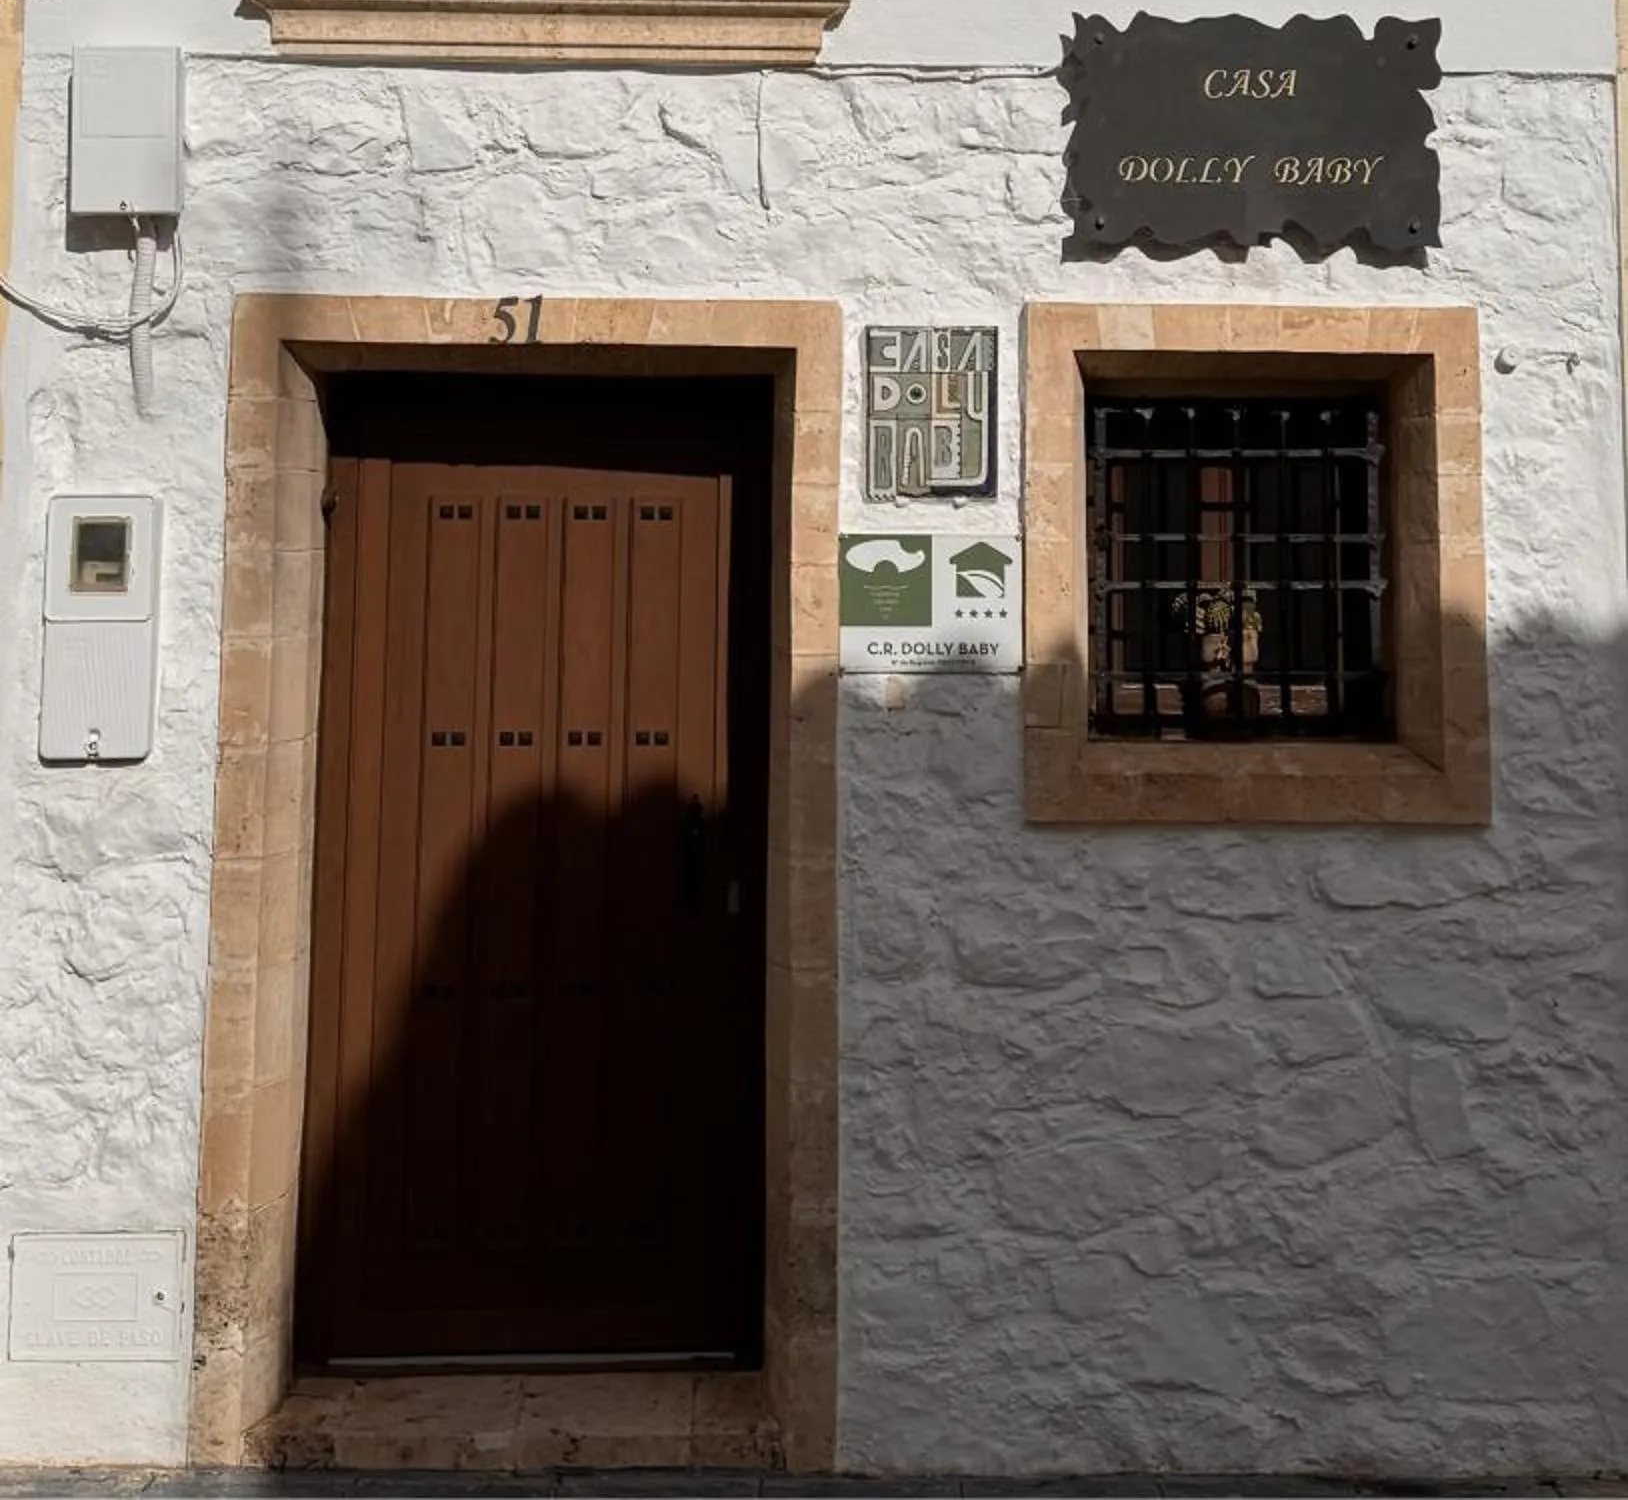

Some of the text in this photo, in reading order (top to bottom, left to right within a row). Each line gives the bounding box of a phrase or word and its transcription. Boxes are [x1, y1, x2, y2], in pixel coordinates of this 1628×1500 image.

[1203, 68, 1297, 99] CASA
[1118, 154, 1385, 186] DOLLY BABY
[487, 294, 543, 344] 51
[867, 641, 1000, 656] C.R. DOLLY BABY
